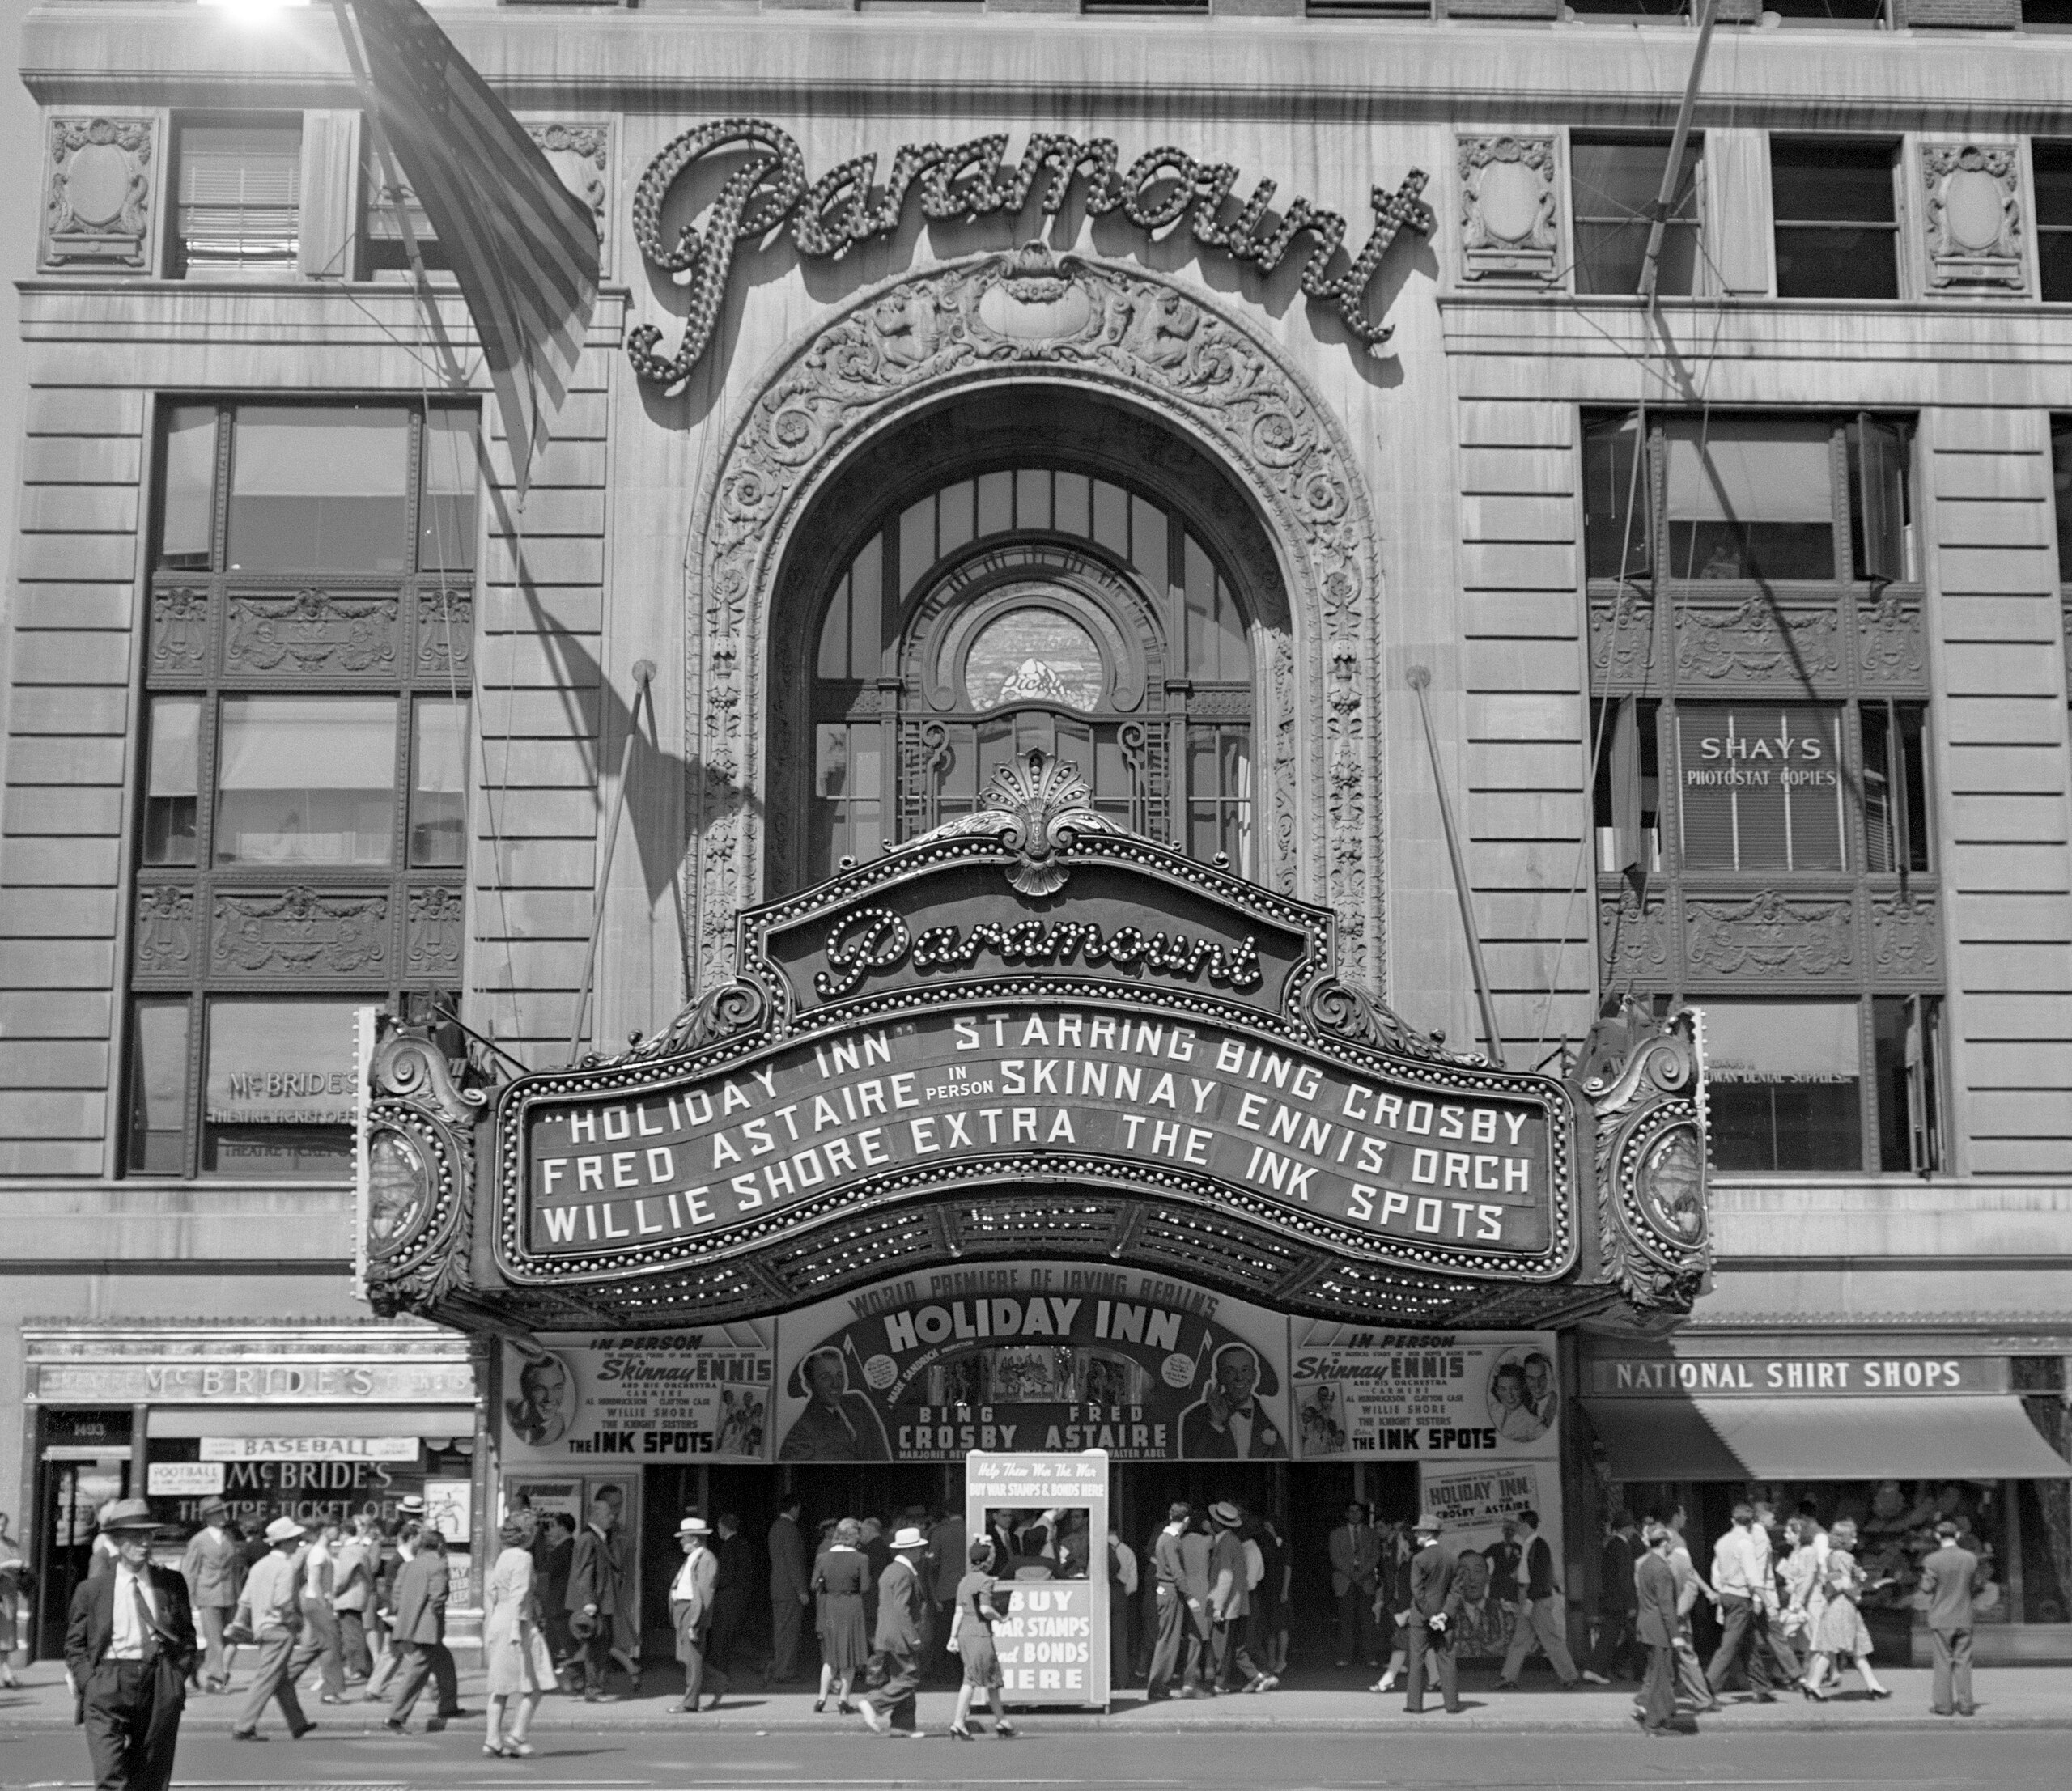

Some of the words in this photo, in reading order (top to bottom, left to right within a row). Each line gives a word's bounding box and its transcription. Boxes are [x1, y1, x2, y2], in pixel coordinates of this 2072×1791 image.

[628, 118, 1430, 383] Paramount
[1700, 737, 1822, 759] SHAYS
[1687, 770, 1770, 785] PHOTOSTAT
[1780, 770, 1836, 785] COPIES
[815, 907, 1259, 993] Paramount
[947, 1067, 966, 1080] IN
[953, 1012, 1196, 1061] STARRING
[1216, 1038, 1323, 1101] BING
[1342, 1084, 1528, 1145] CROSBY
[925, 1080, 994, 1101] PERSON
[544, 1146, 675, 1195] FRED
[713, 1072, 919, 1169] ASTAIRE
[1000, 1059, 1216, 1114] SKINNAY
[1237, 1093, 1386, 1175] ENNIS
[1411, 1148, 1529, 1194] ORCH
[543, 1186, 716, 1243] WILLIE
[731, 1126, 890, 1212] SHORE
[910, 1107, 1076, 1155] EXTRA
[1122, 1114, 1214, 1165] THE
[1245, 1146, 1318, 1202] INK
[1346, 1182, 1503, 1241] SPOTS
[847, 1280, 916, 1318] WORLD
[931, 1269, 1017, 1297] PREMIERE
[1031, 1268, 1052, 1291] OF
[1064, 1270, 1127, 1296] IRVING
[883, 1297, 1083, 1353] HOLIDAY
[1095, 1300, 1182, 1352] INN
[590, 1339, 614, 1350] IN
[619, 1334, 703, 1350] PERSON
[1348, 1333, 1374, 1348] IN
[1381, 1335, 1455, 1349] PERSON
[597, 1359, 696, 1382] Skinnay
[697, 1359, 771, 1381] ENNIS
[887, 1379, 906, 1404] MARK
[902, 1348, 939, 1381] SANDRICH
[1293, 1356, 1389, 1380] Skinnay
[1391, 1356, 1463, 1378] ENNIS
[1617, 1362, 1753, 1388] NATIONAL
[1767, 1362, 1849, 1388] SHIRT
[1865, 1361, 1960, 1387] SHOPS
[607, 1408, 645, 1417] WILLIE
[654, 1408, 694, 1417] SHORE
[919, 1407, 993, 1423] BING
[1069, 1406, 1143, 1423] FRED
[1362, 1405, 1399, 1414] WILLIE
[1408, 1405, 1446, 1414] SHORE
[601, 1420, 617, 1429] THE
[1359, 1417, 1374, 1426] THE
[1416, 1417, 1451, 1426] SISTERS
[568, 1439, 592, 1453] THE
[593, 1432, 635, 1453] INK
[643, 1432, 713, 1453] SPOTS
[898, 1424, 1017, 1449] CROSBY
[1045, 1424, 1166, 1449] ASTAIRE
[1352, 1437, 1374, 1450] THE
[1378, 1428, 1419, 1450] INK
[1429, 1428, 1496, 1449] SPOTS
[244, 1439, 374, 1456] BASEBALL
[899, 1449, 945, 1459] MARJORIE
[1144, 1449, 1166, 1458] ABEL
[154, 1466, 217, 1477] FOOTBALL
[978, 1462, 1000, 1479] Help
[1003, 1462, 1029, 1477] Them
[1032, 1463, 1051, 1477] Win
[1055, 1463, 1072, 1477] The
[1076, 1463, 1096, 1477] War
[970, 1483, 987, 1496] BUY
[987, 1483, 1007, 1496] WAR
[1008, 1483, 1040, 1496] STAMPS
[1042, 1483, 1050, 1496] &
[1051, 1483, 1079, 1496] BONDS
[1081, 1483, 1103, 1496] HERE
[1429, 1480, 1491, 1505] HOLIDAY
[1499, 1476, 1529, 1497] INN
[1436, 1508, 1475, 1519] CROSBY
[1485, 1500, 1530, 1514] ASTAIRE
[1009, 1591, 1073, 1611] BUY
[992, 1618, 1024, 1637] WAR
[1027, 1617, 1089, 1637] STAMPS
[1024, 1642, 1089, 1663] BONDS
